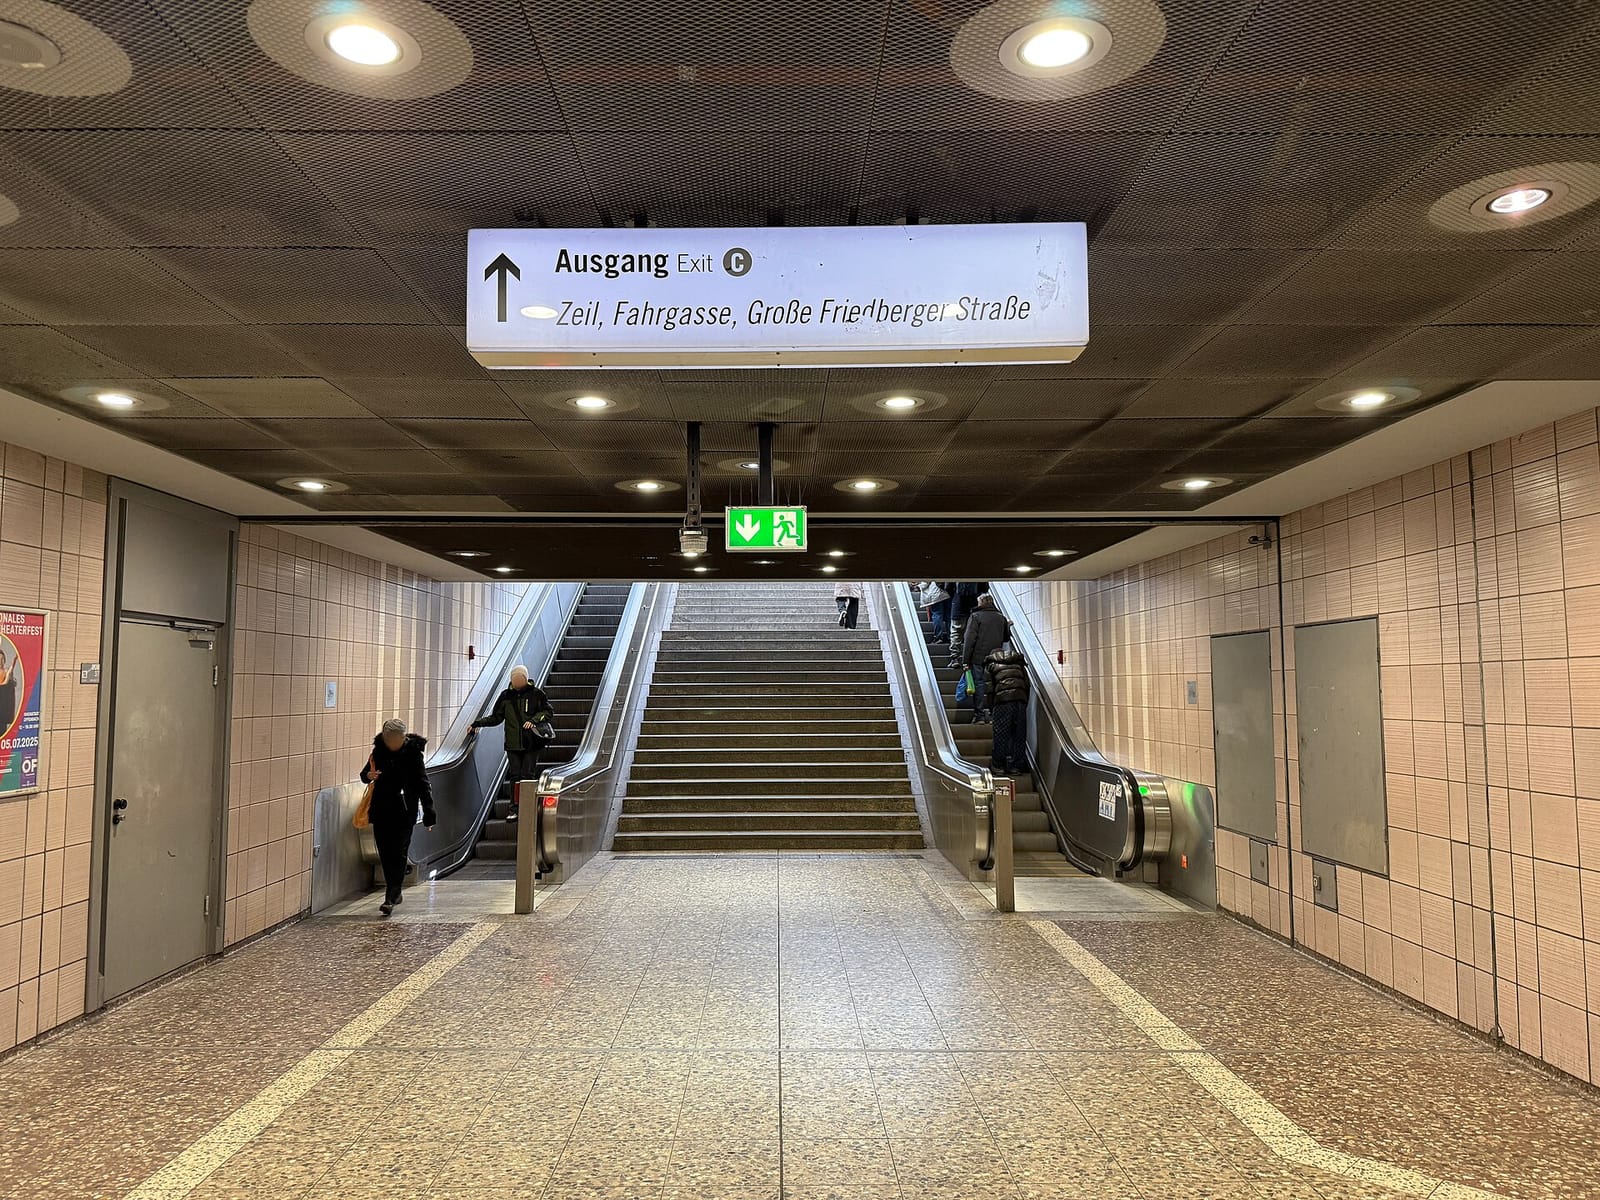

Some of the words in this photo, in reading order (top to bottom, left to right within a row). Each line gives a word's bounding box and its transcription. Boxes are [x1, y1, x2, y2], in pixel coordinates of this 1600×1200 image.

[555, 248, 669, 279] Ausgang
[677, 253, 713, 273] Exit
[556, 301, 603, 330] Zeil,
[613, 301, 737, 331] Fahrgasse,
[747, 299, 813, 325] Große
[819, 298, 949, 328] Friedberger
[955, 295, 1031, 322] Straße
[22, 758, 38, 774] OF
